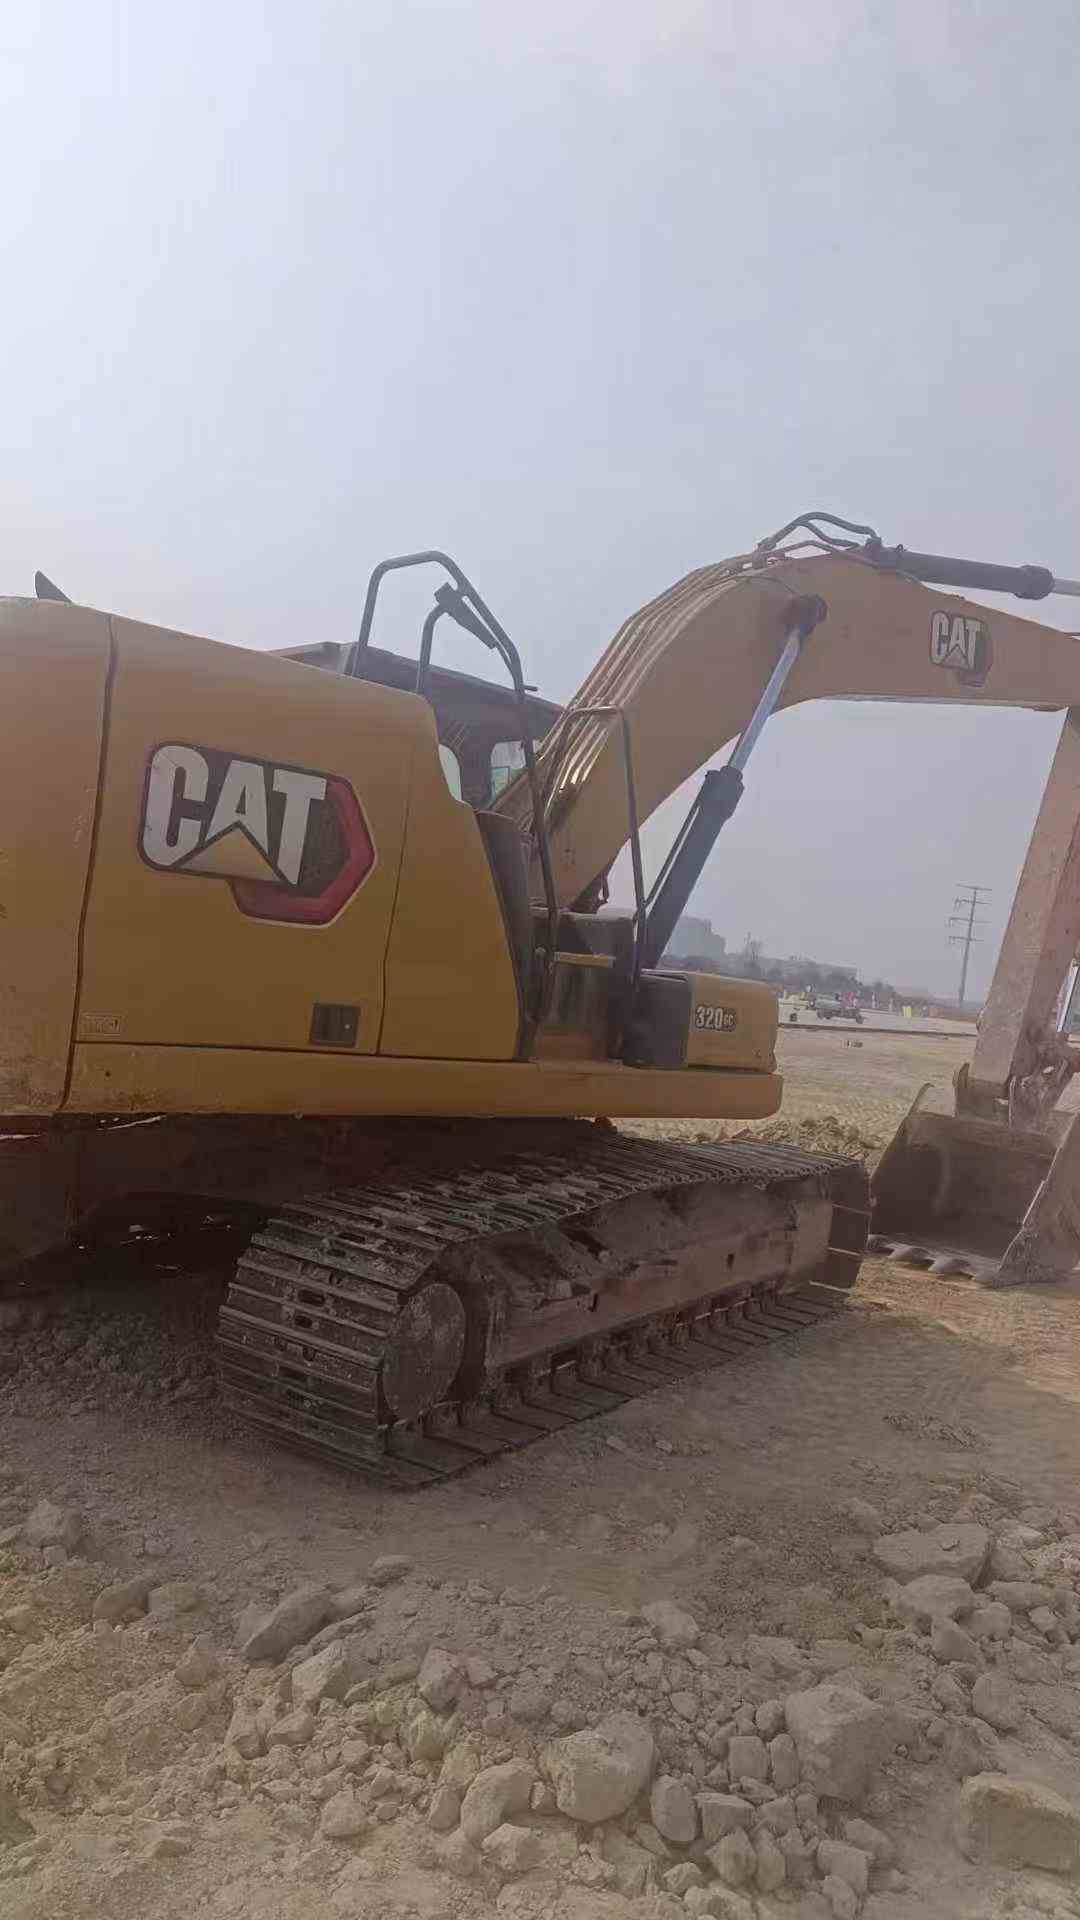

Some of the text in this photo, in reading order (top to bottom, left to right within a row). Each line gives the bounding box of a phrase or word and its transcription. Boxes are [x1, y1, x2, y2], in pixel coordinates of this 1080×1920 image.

[931, 611, 983, 669] CAT
[143, 745, 328, 886] CAT
[696, 1006, 723, 1029] 320
